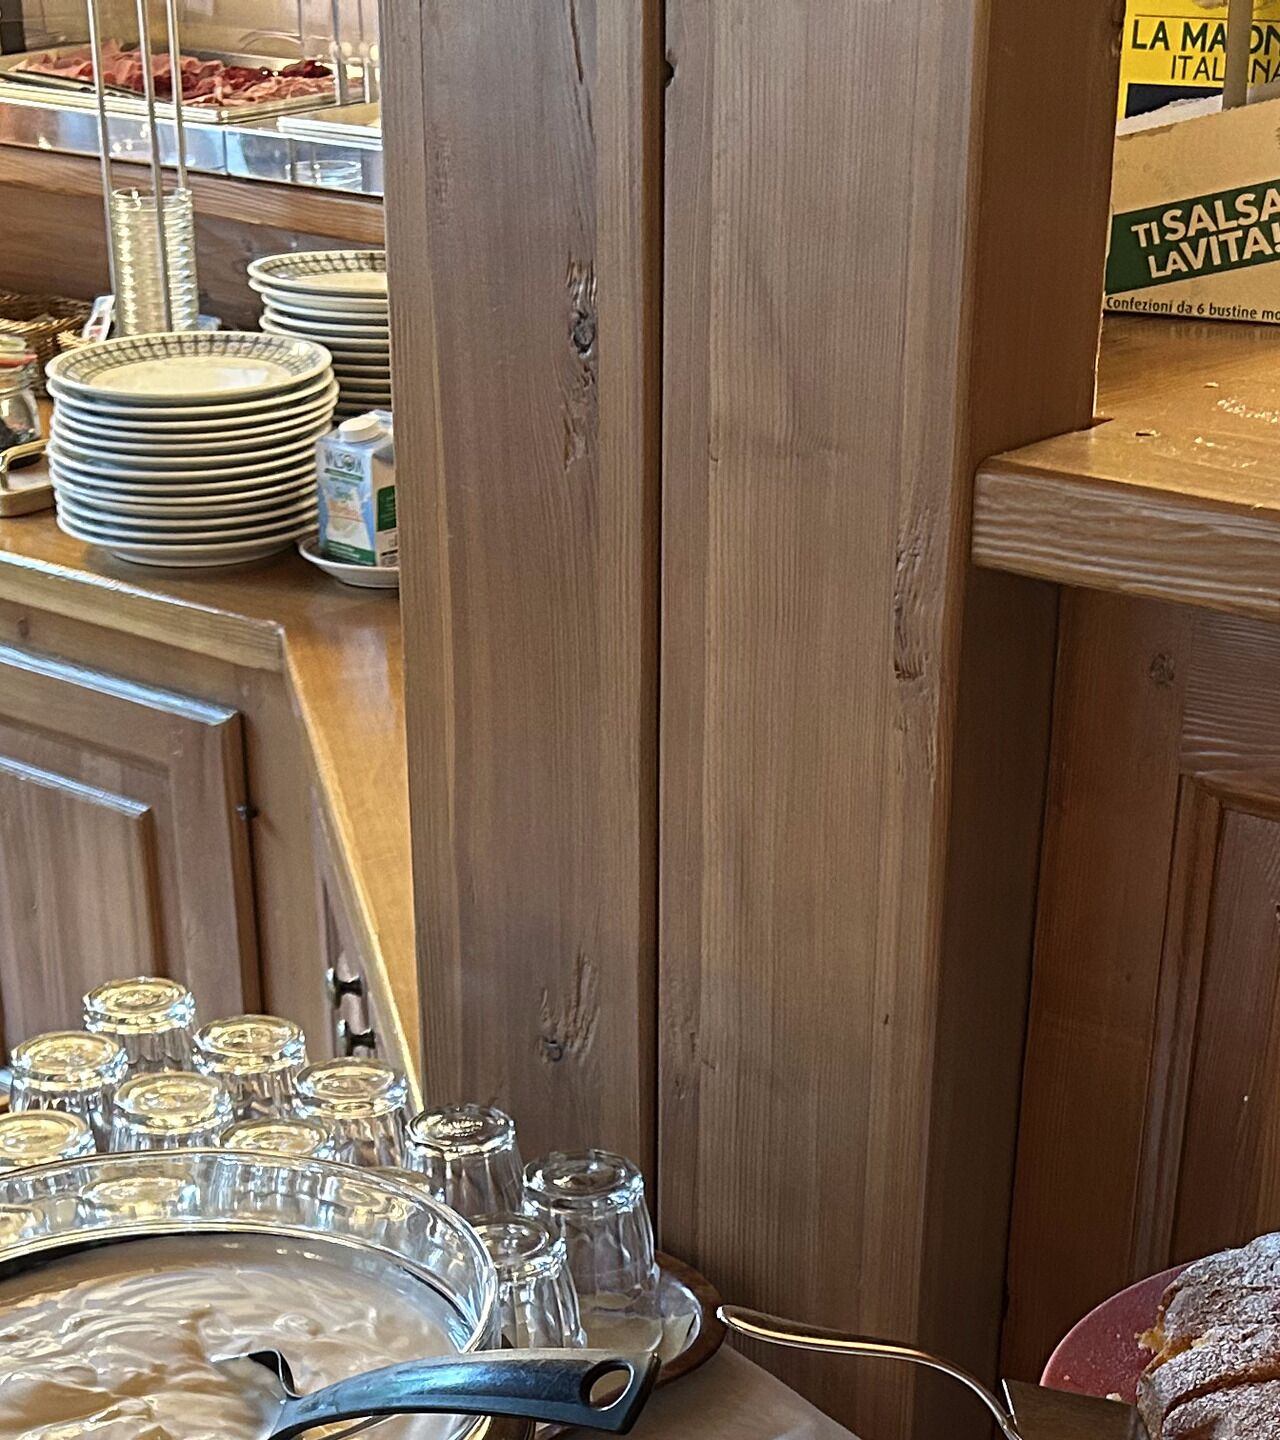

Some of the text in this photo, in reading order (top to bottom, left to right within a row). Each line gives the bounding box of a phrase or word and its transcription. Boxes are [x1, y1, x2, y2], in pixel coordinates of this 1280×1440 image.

[1131, 19, 1170, 50] LA
[1131, 221, 1160, 248] TI
[1148, 250, 1188, 279] LA
[1106, 297, 1173, 313] Confezioni
[1177, 301, 1193, 315] da
[1197, 303, 1205, 315] 6
[1209, 304, 1257, 320] bustine
